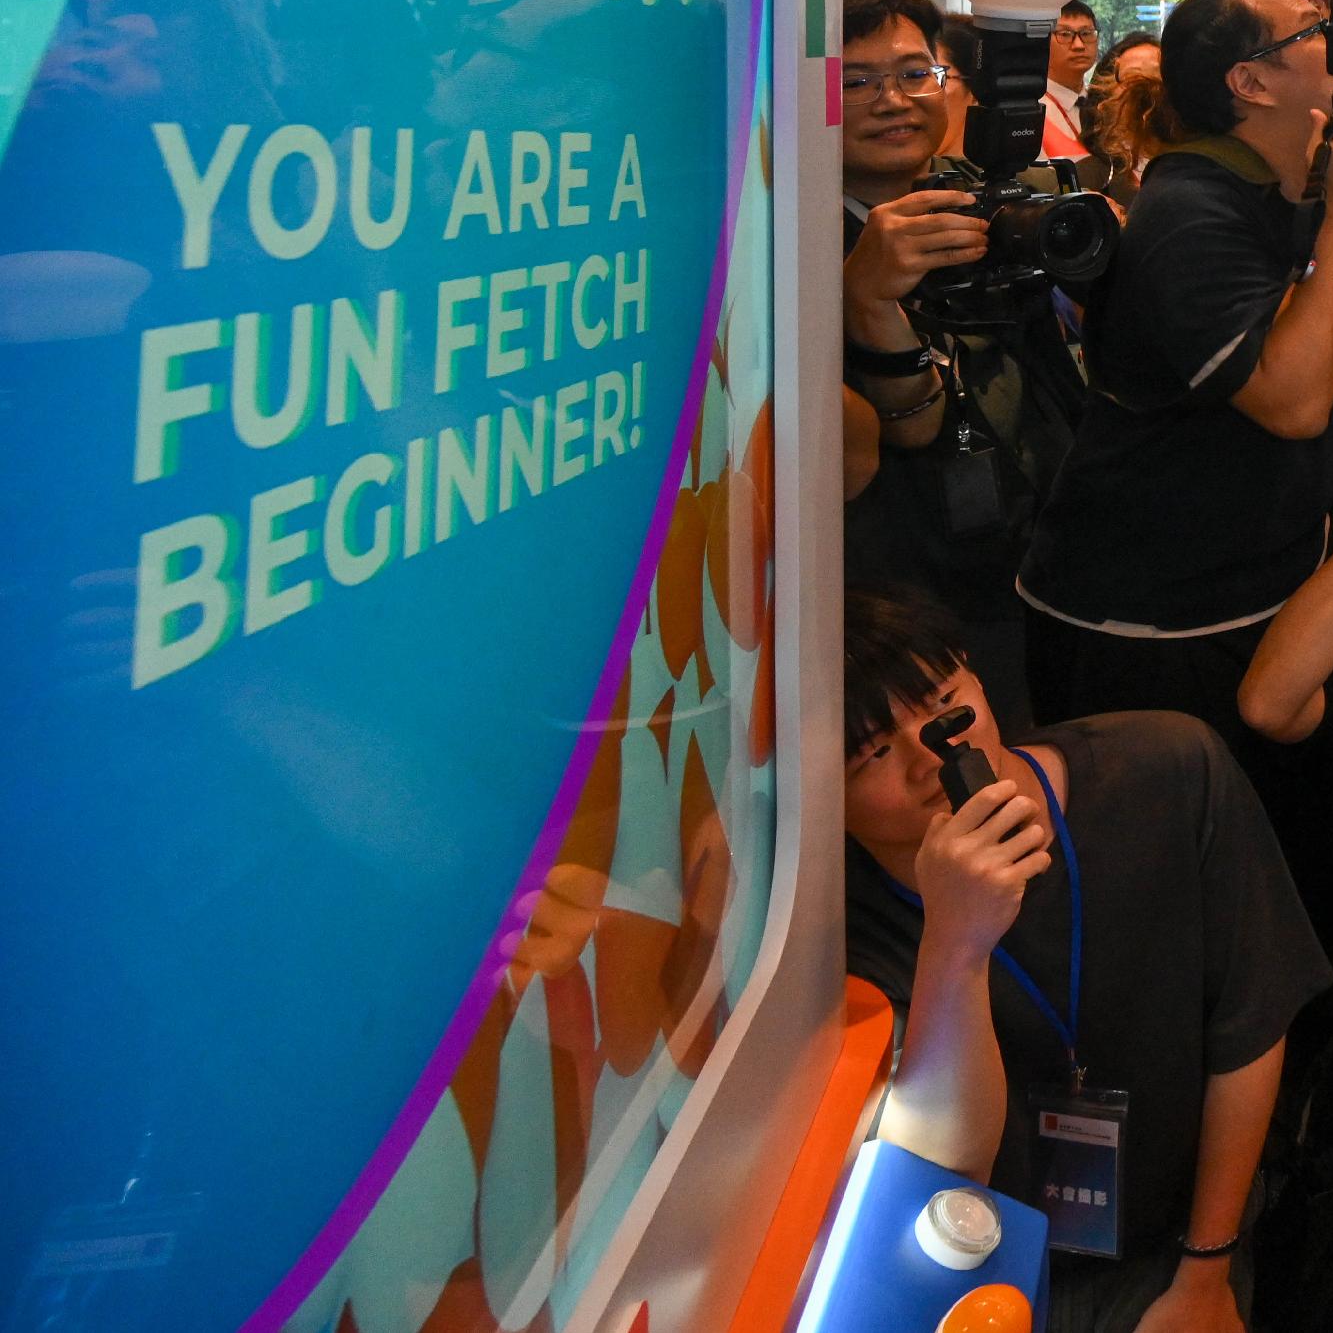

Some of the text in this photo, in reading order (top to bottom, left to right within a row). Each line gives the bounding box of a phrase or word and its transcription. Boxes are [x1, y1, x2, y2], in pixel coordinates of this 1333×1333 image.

[151, 122, 648, 270] YOU ARE A
[134, 249, 650, 485] FUN FETCH
[131, 360, 644, 692] BEGINNER!
